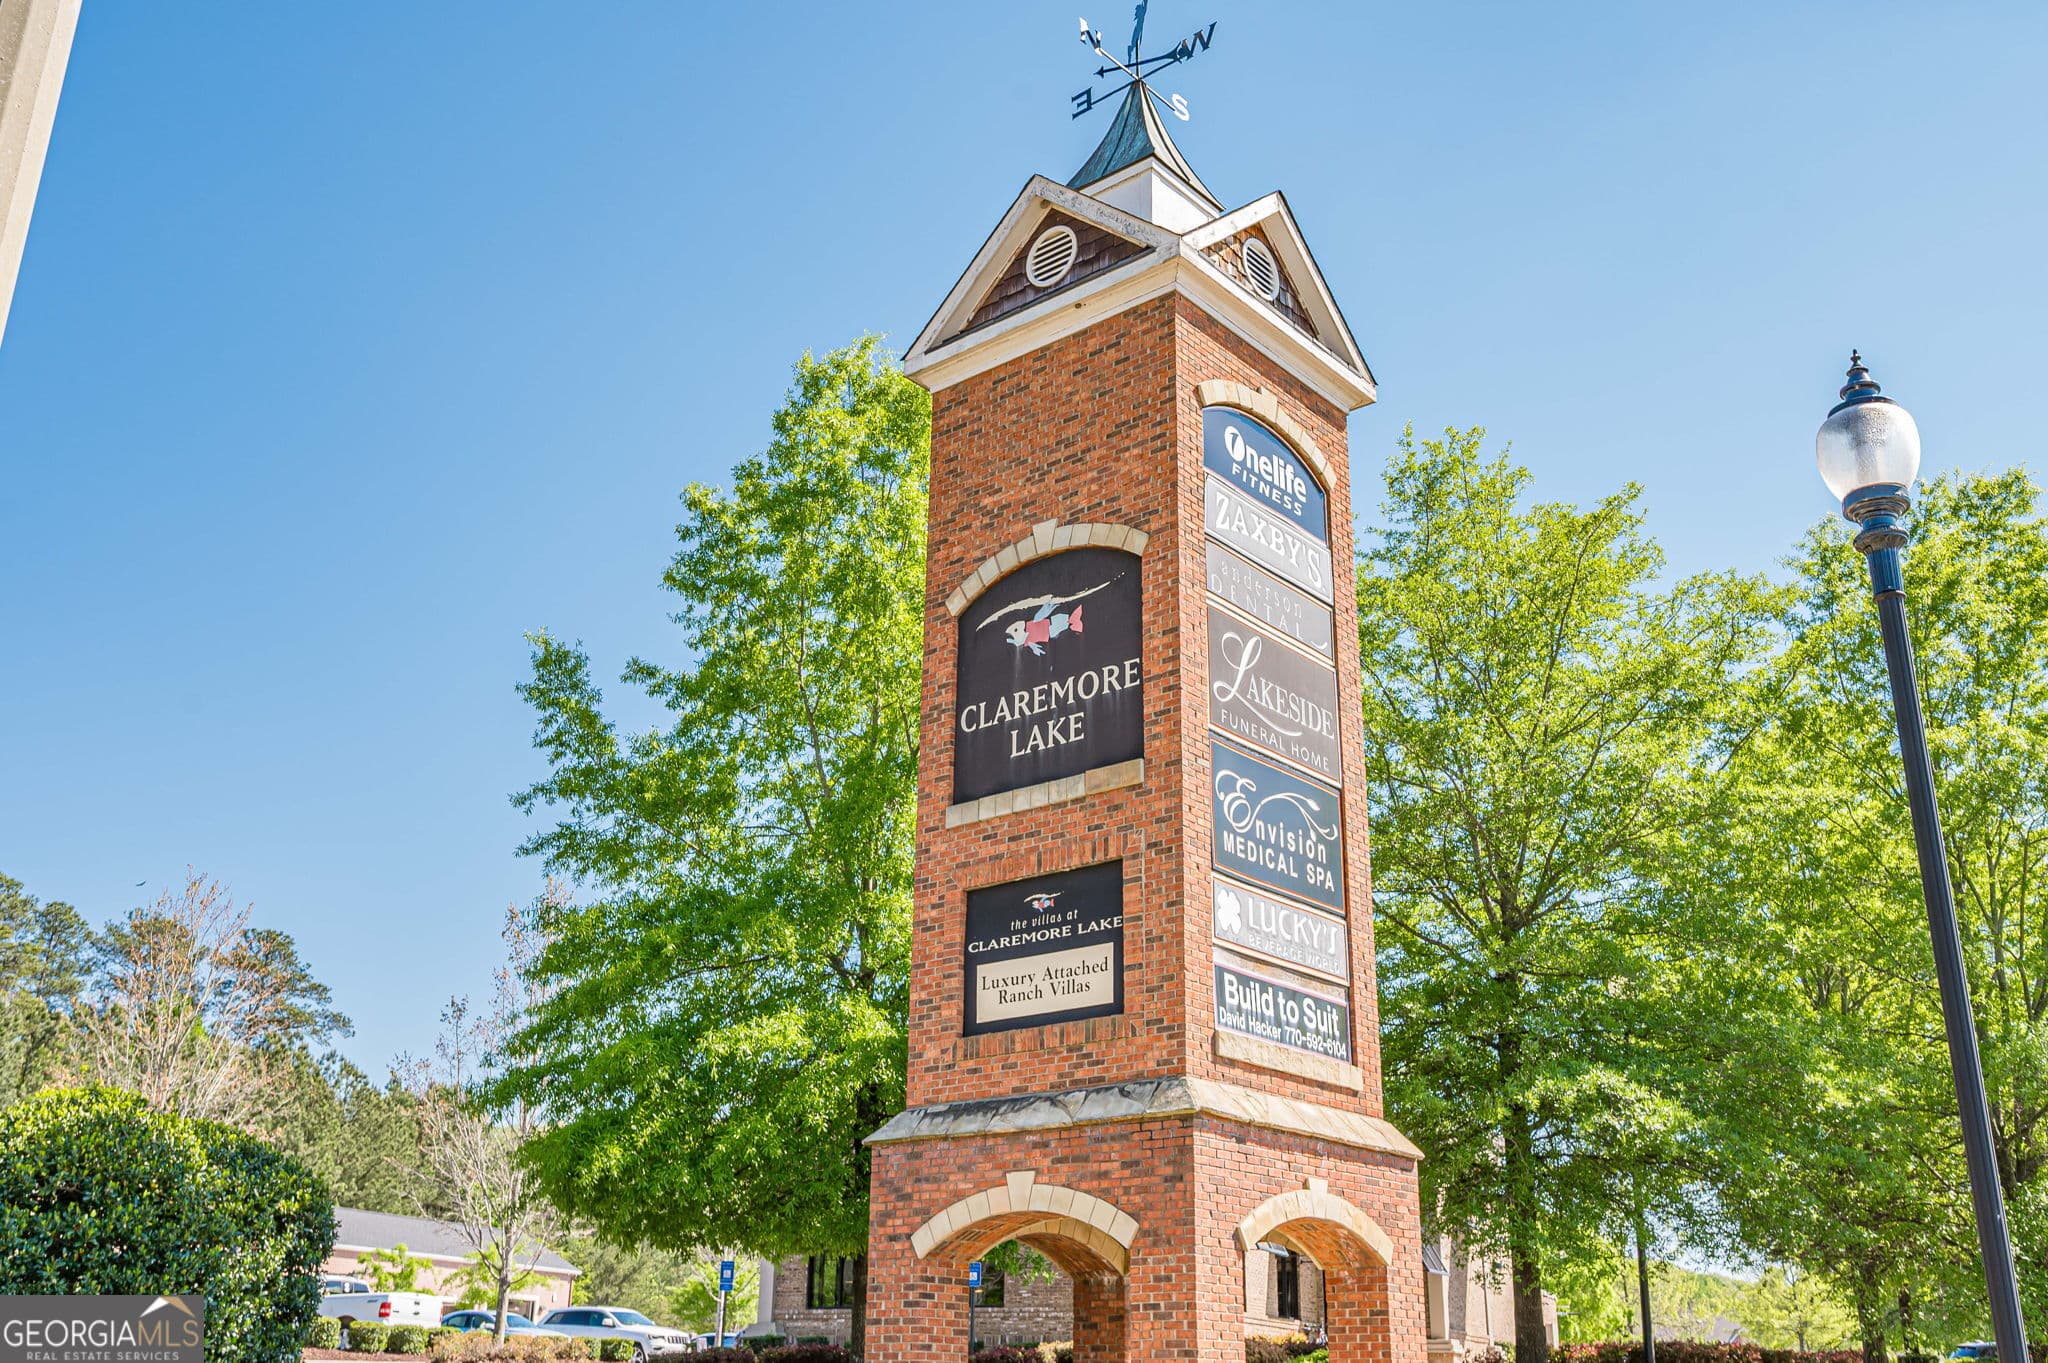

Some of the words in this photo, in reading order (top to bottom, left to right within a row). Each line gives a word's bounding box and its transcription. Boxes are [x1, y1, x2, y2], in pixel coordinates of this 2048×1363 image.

[1171, 93, 1190, 121] S
[1224, 425, 1307, 504] Onelife
[1231, 462, 1303, 517] FITNESS
[1215, 491, 1322, 587] ZAXBY'S
[1211, 573, 1304, 641] DENTAL
[960, 657, 1141, 733] CLAREMORE
[1213, 631, 1335, 740] LAKESIDE
[1010, 711, 1085, 759] LAKE
[1221, 708, 1285, 751] FUNERAL
[1291, 743, 1330, 772] HOME
[1215, 769, 1330, 865] Envision
[1223, 829, 1299, 878] MEDICAL
[1306, 863, 1335, 892] SPA
[967, 924, 1072, 954] CLAREMORE
[1077, 914, 1124, 935] LAKE
[1010, 919, 1027, 932] the
[1031, 912, 1062, 928] villas
[1066, 908, 1079, 921] at
[981, 973, 1036, 992] Luxury
[1042, 956, 1109, 982] Attached
[998, 984, 1044, 1005] Ranch
[1050, 979, 1092, 997] Villas
[1223, 971, 1275, 1018] Build
[1277, 990, 1300, 1023] to
[1302, 997, 1340, 1037] Suit
[1218, 1006, 1246, 1030] David
[1248, 1015, 1282, 1040] Hacker
